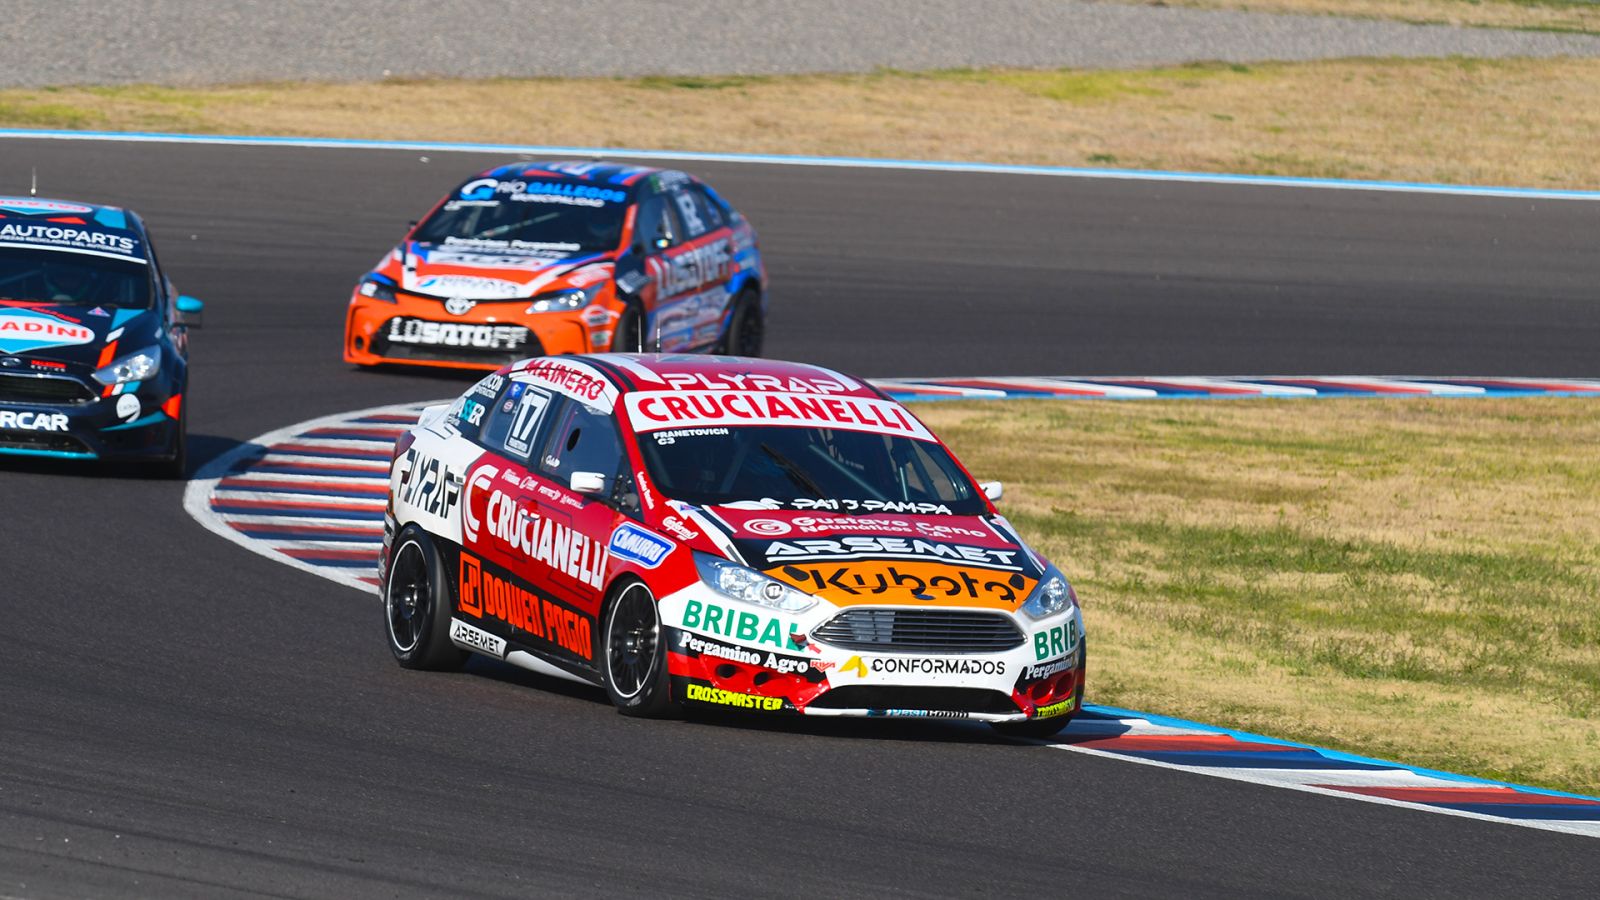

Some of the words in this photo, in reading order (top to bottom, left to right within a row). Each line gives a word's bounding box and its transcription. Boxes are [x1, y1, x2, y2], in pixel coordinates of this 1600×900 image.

[527, 182, 627, 203] GALLEGOS
[0, 224, 134, 250] AUTOPARTS
[0, 321, 88, 338] ADINI
[524, 359, 606, 401] MAINERO
[661, 373, 847, 395] PLYRAP
[0, 411, 69, 431] RCAR
[512, 391, 549, 442] 17
[638, 394, 914, 431] CRUCIANELLI
[653, 427, 729, 440] FRANETOVICH
[658, 437, 675, 446] C3
[860, 499, 953, 516] PAMPA
[791, 515, 912, 529] Gustavo
[915, 522, 988, 538] Cano
[800, 523, 913, 534] Neumáticos
[487, 489, 610, 592] CRUCIANELLI
[765, 536, 1018, 565] ARSEMET
[808, 567, 1017, 602] Kubota
[454, 624, 500, 654] ARSEMET
[681, 599, 805, 653] BRIBAL
[679, 631, 761, 665] Pergamino
[763, 652, 809, 674] Agro
[872, 657, 1007, 676] CONFORMADOS
[687, 683, 783, 711] CROSSMASTER
